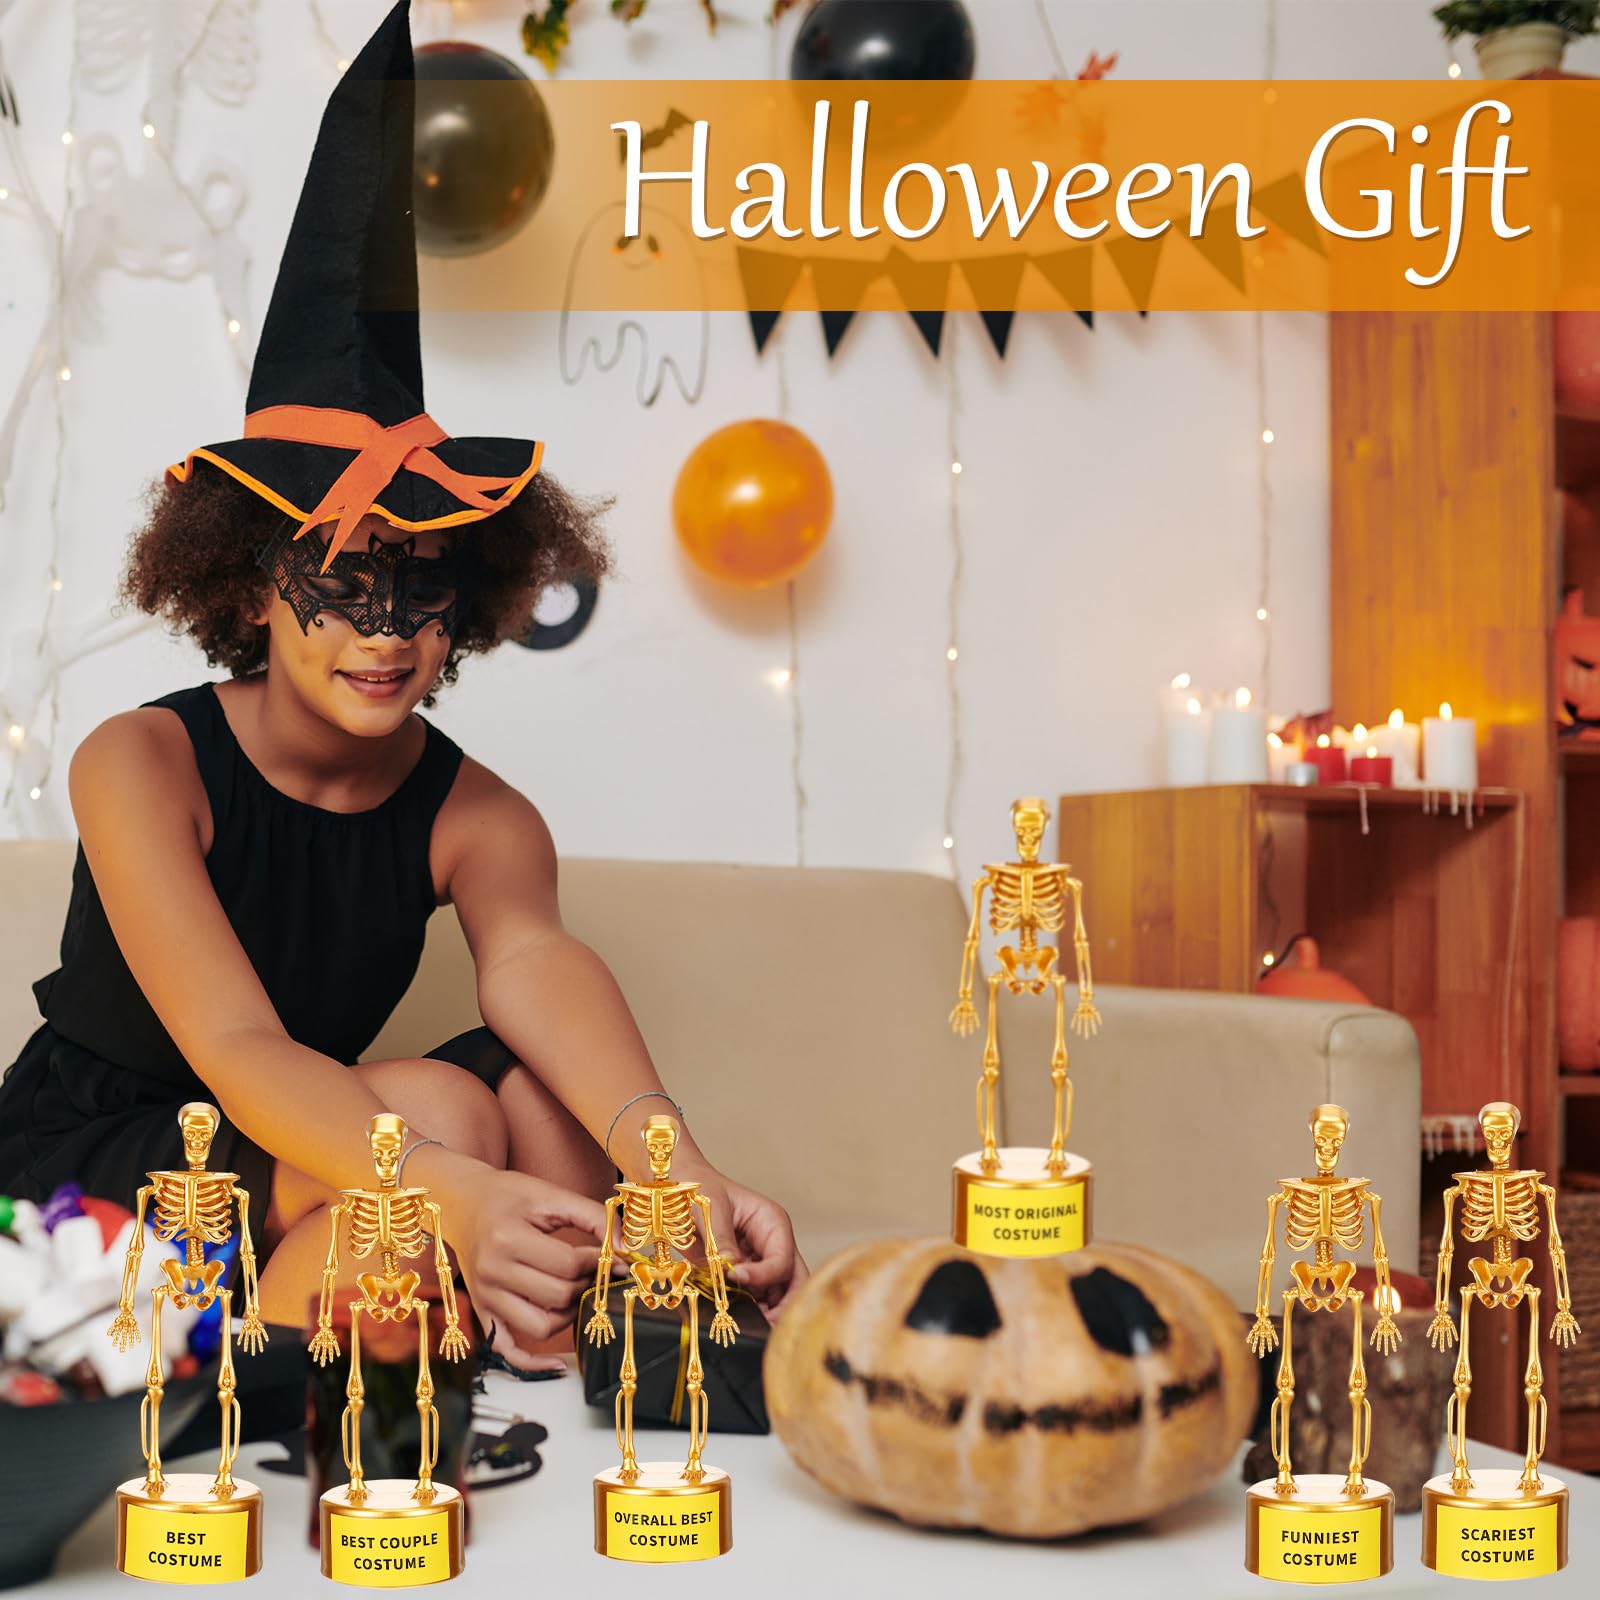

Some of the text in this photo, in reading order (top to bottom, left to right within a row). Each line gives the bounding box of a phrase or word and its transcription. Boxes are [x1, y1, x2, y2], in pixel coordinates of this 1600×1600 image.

[974, 1204, 1078, 1220] MOST ORIGINAL
[993, 1226, 1060, 1241] COSTUME
[614, 1510, 713, 1527] OVERALL BEST
[166, 1531, 207, 1546] BEST
[341, 1532, 438, 1550] BEST COUPLE
[629, 1533, 699, 1547] COSTUME
[1281, 1530, 1360, 1545] FUNNIEST
[1460, 1526, 1536, 1542] SCARIEST
[148, 1550, 223, 1568] COSTUME
[353, 1555, 426, 1571] COSTUME
[1282, 1552, 1358, 1567] COSTUME
[1460, 1548, 1535, 1564] COSTUME
